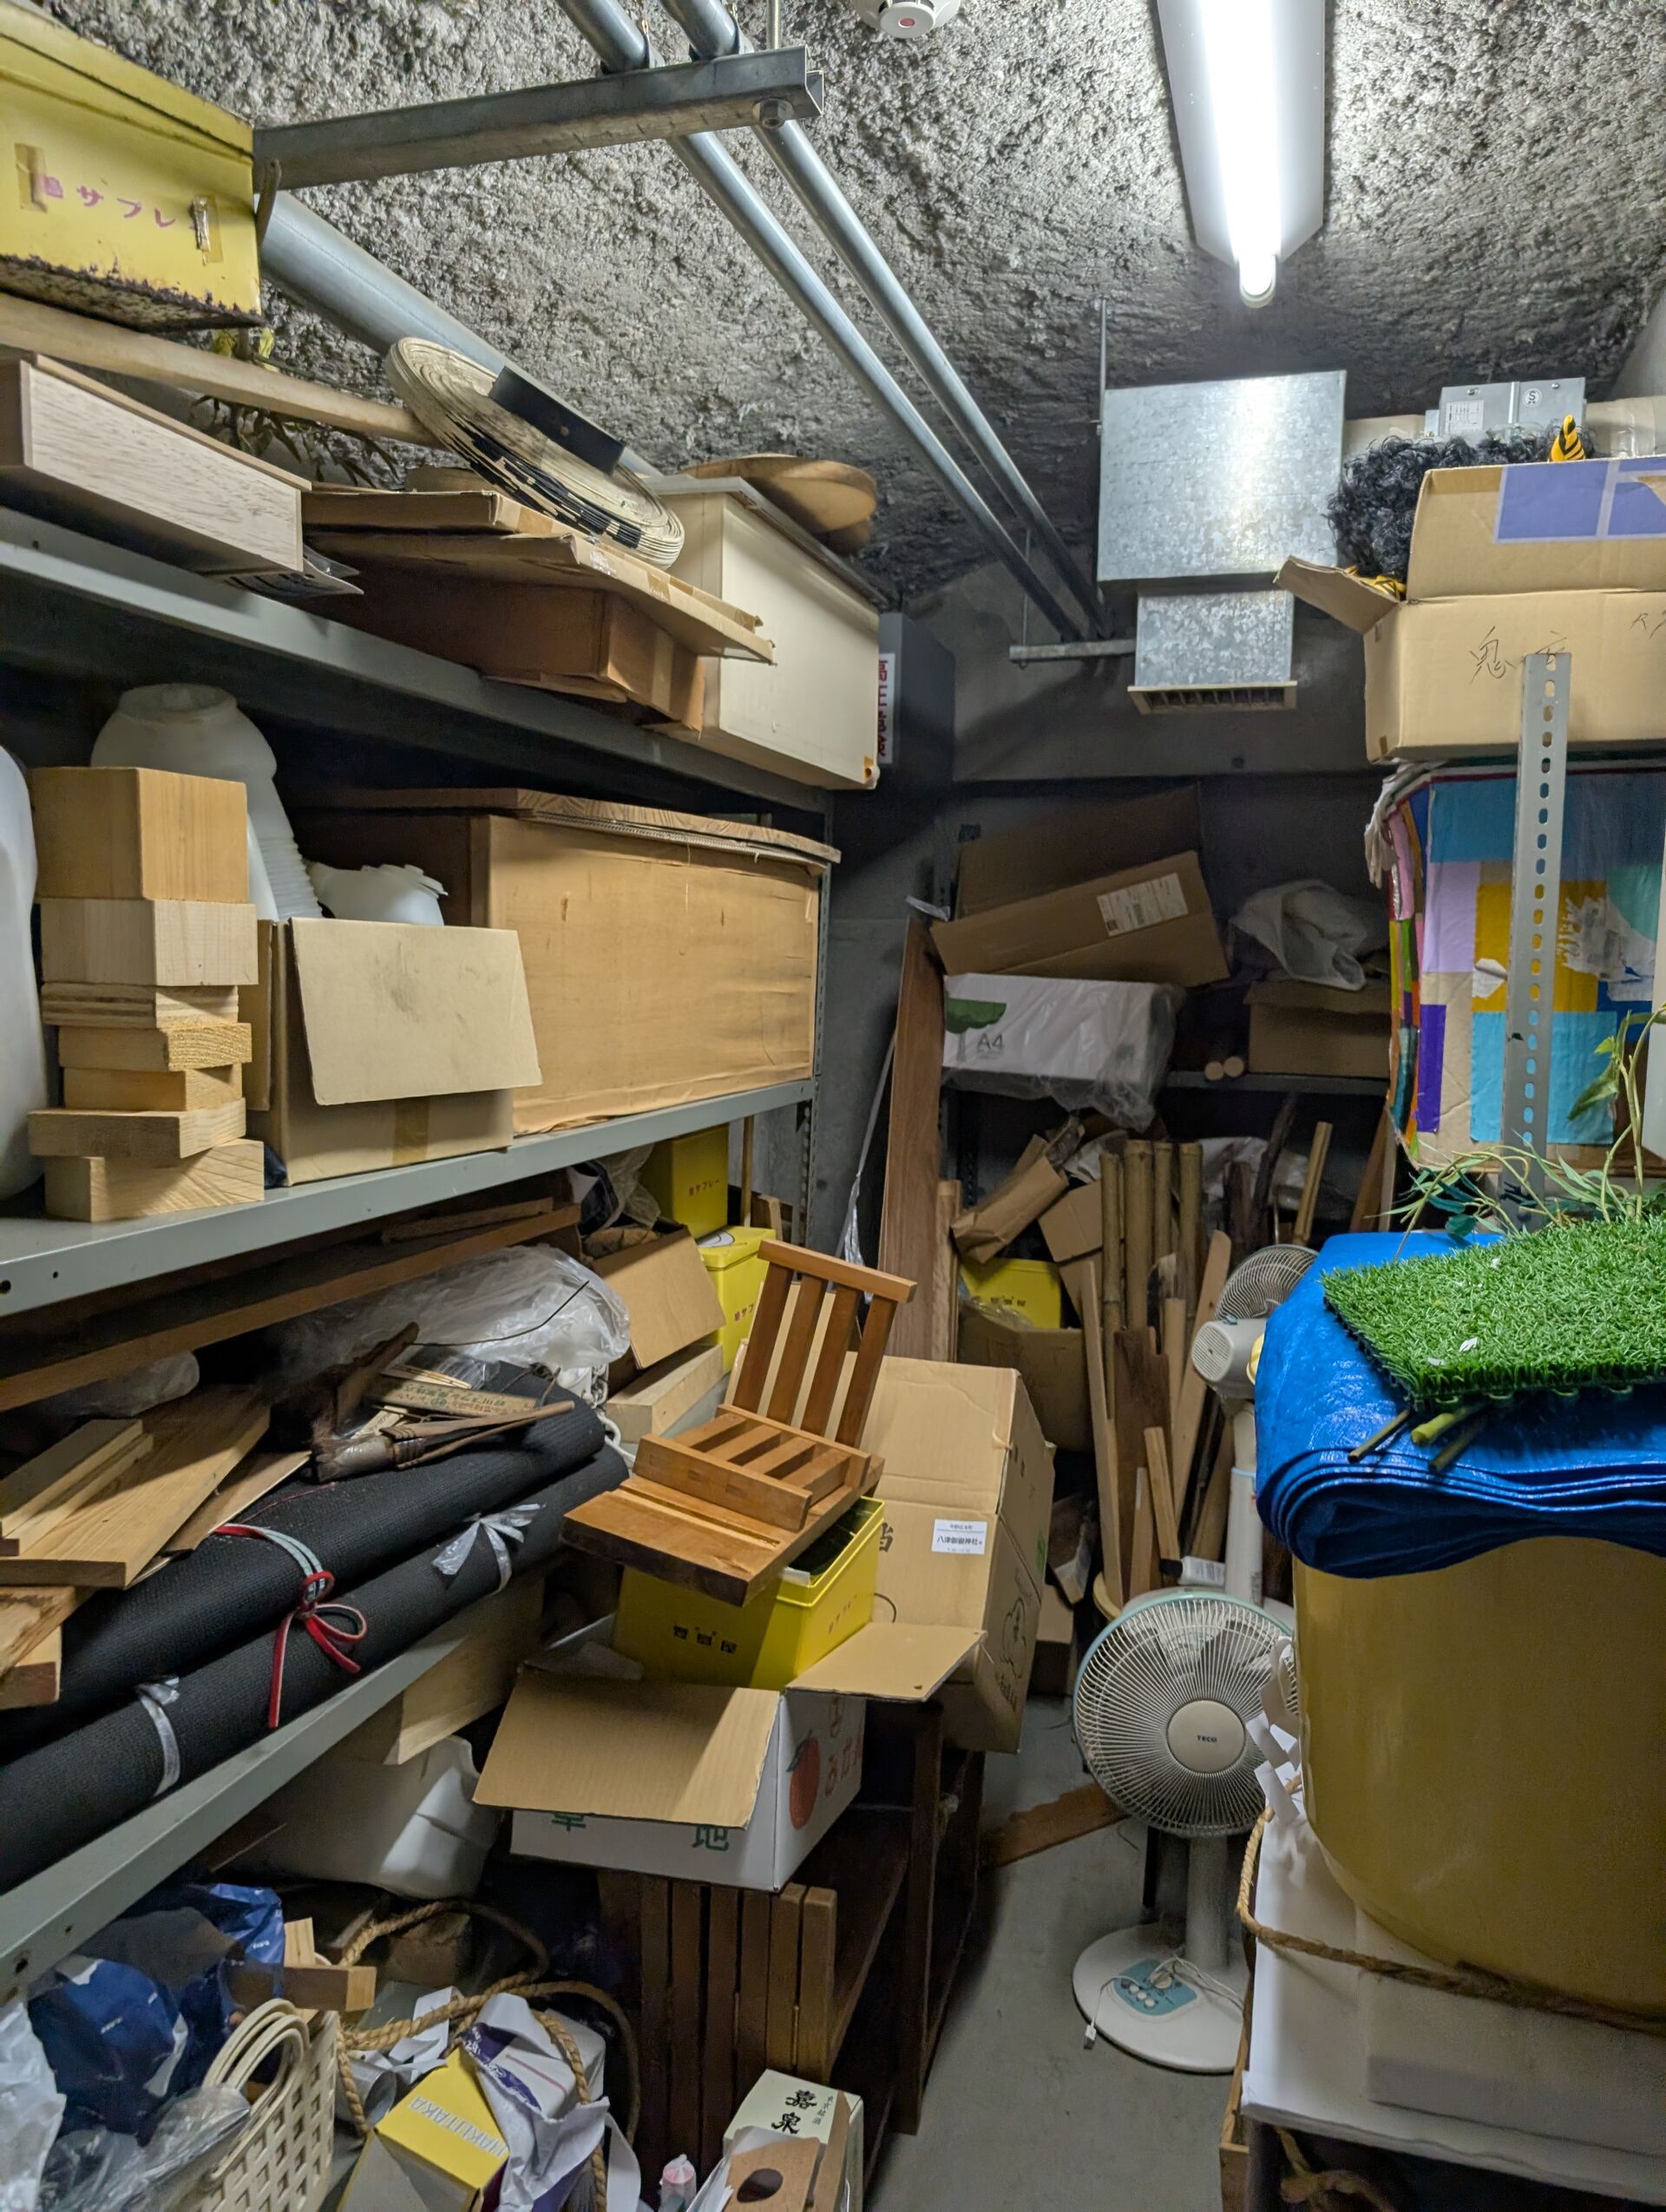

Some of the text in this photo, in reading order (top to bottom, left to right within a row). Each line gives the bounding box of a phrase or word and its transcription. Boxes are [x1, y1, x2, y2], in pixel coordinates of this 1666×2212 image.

[977, 1033, 1004, 1050] A4
[1197, 1734, 1218, 1744] TECO
[410, 2096, 508, 2158] HAKUTAKA
